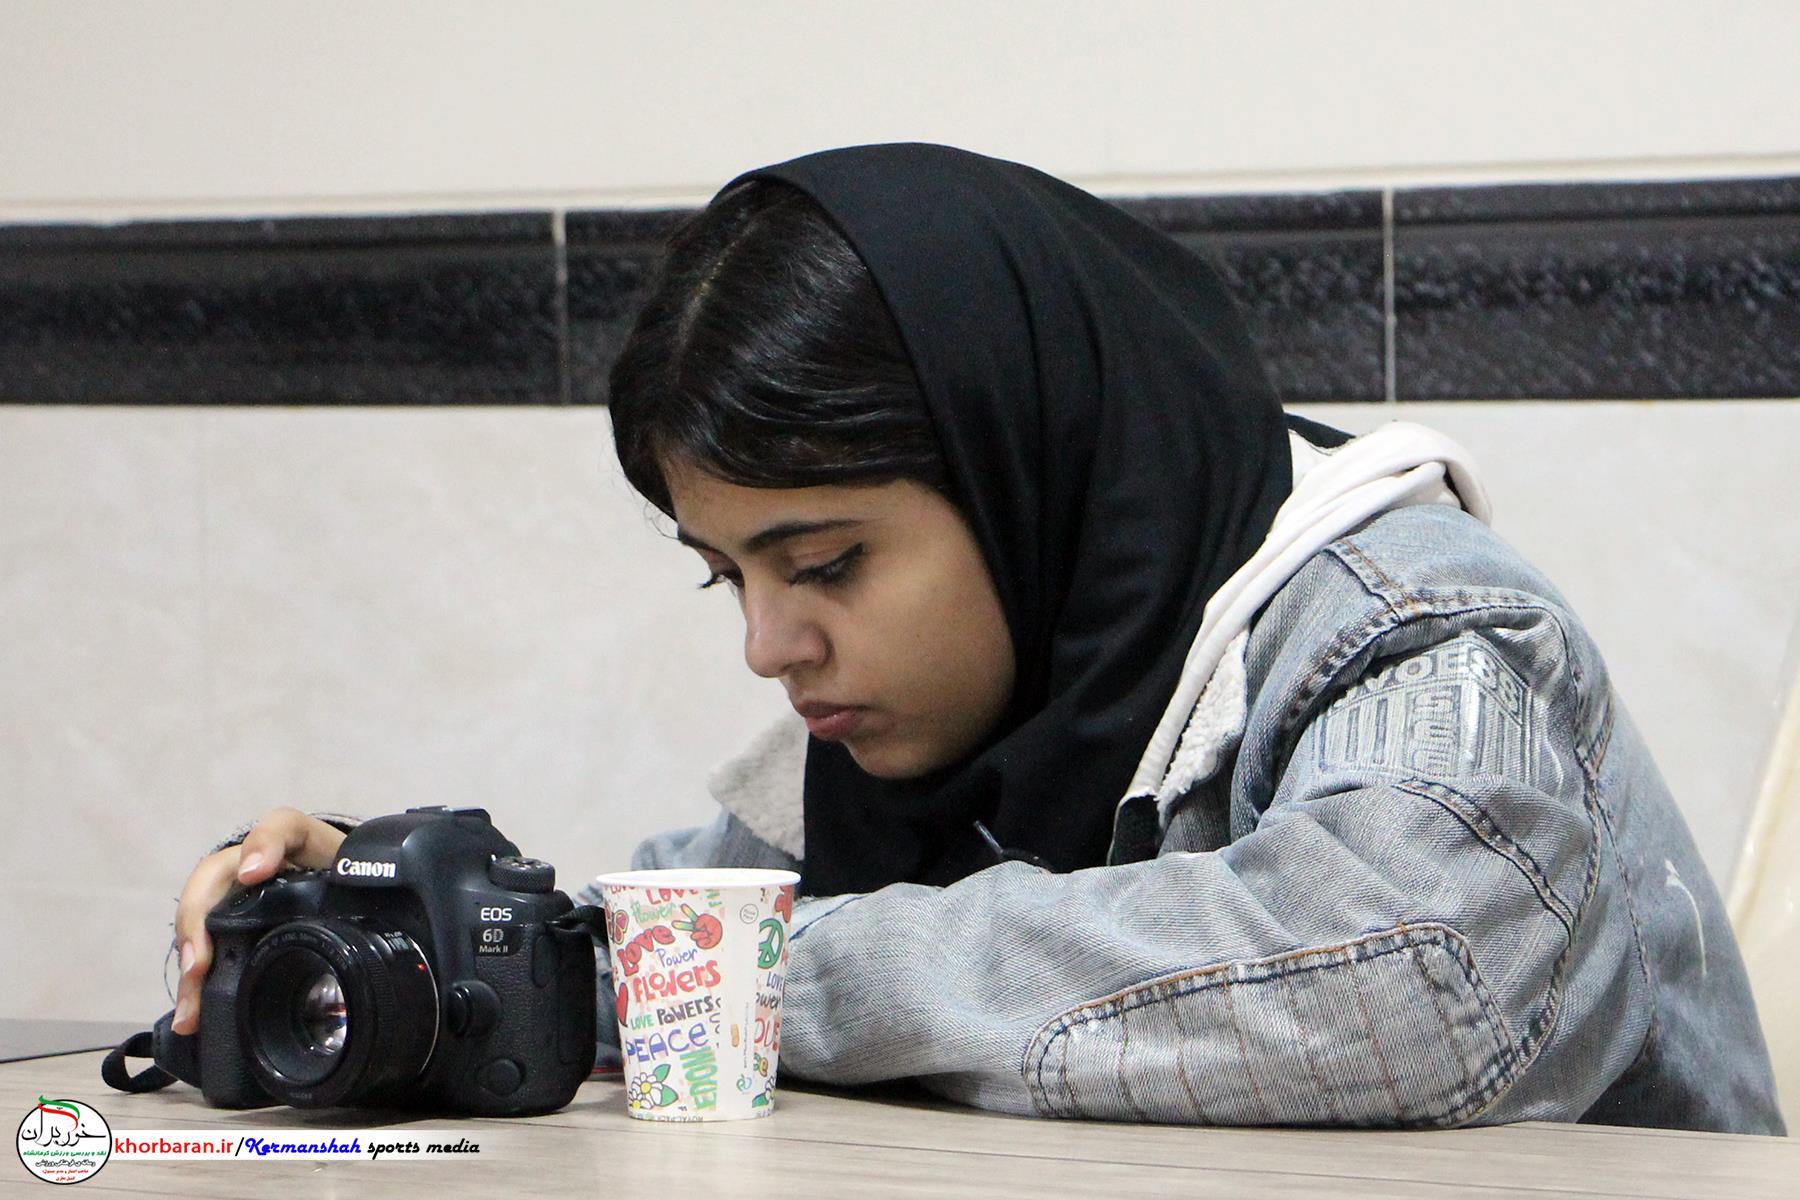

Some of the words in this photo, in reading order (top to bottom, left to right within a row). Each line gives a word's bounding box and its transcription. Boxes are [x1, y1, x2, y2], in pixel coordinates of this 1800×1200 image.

[337, 857, 396, 878] Canon
[480, 907, 513, 921] EOS
[482, 928, 504, 943] 6D
[479, 944, 501, 953] Mark
[656, 948, 698, 968] Power
